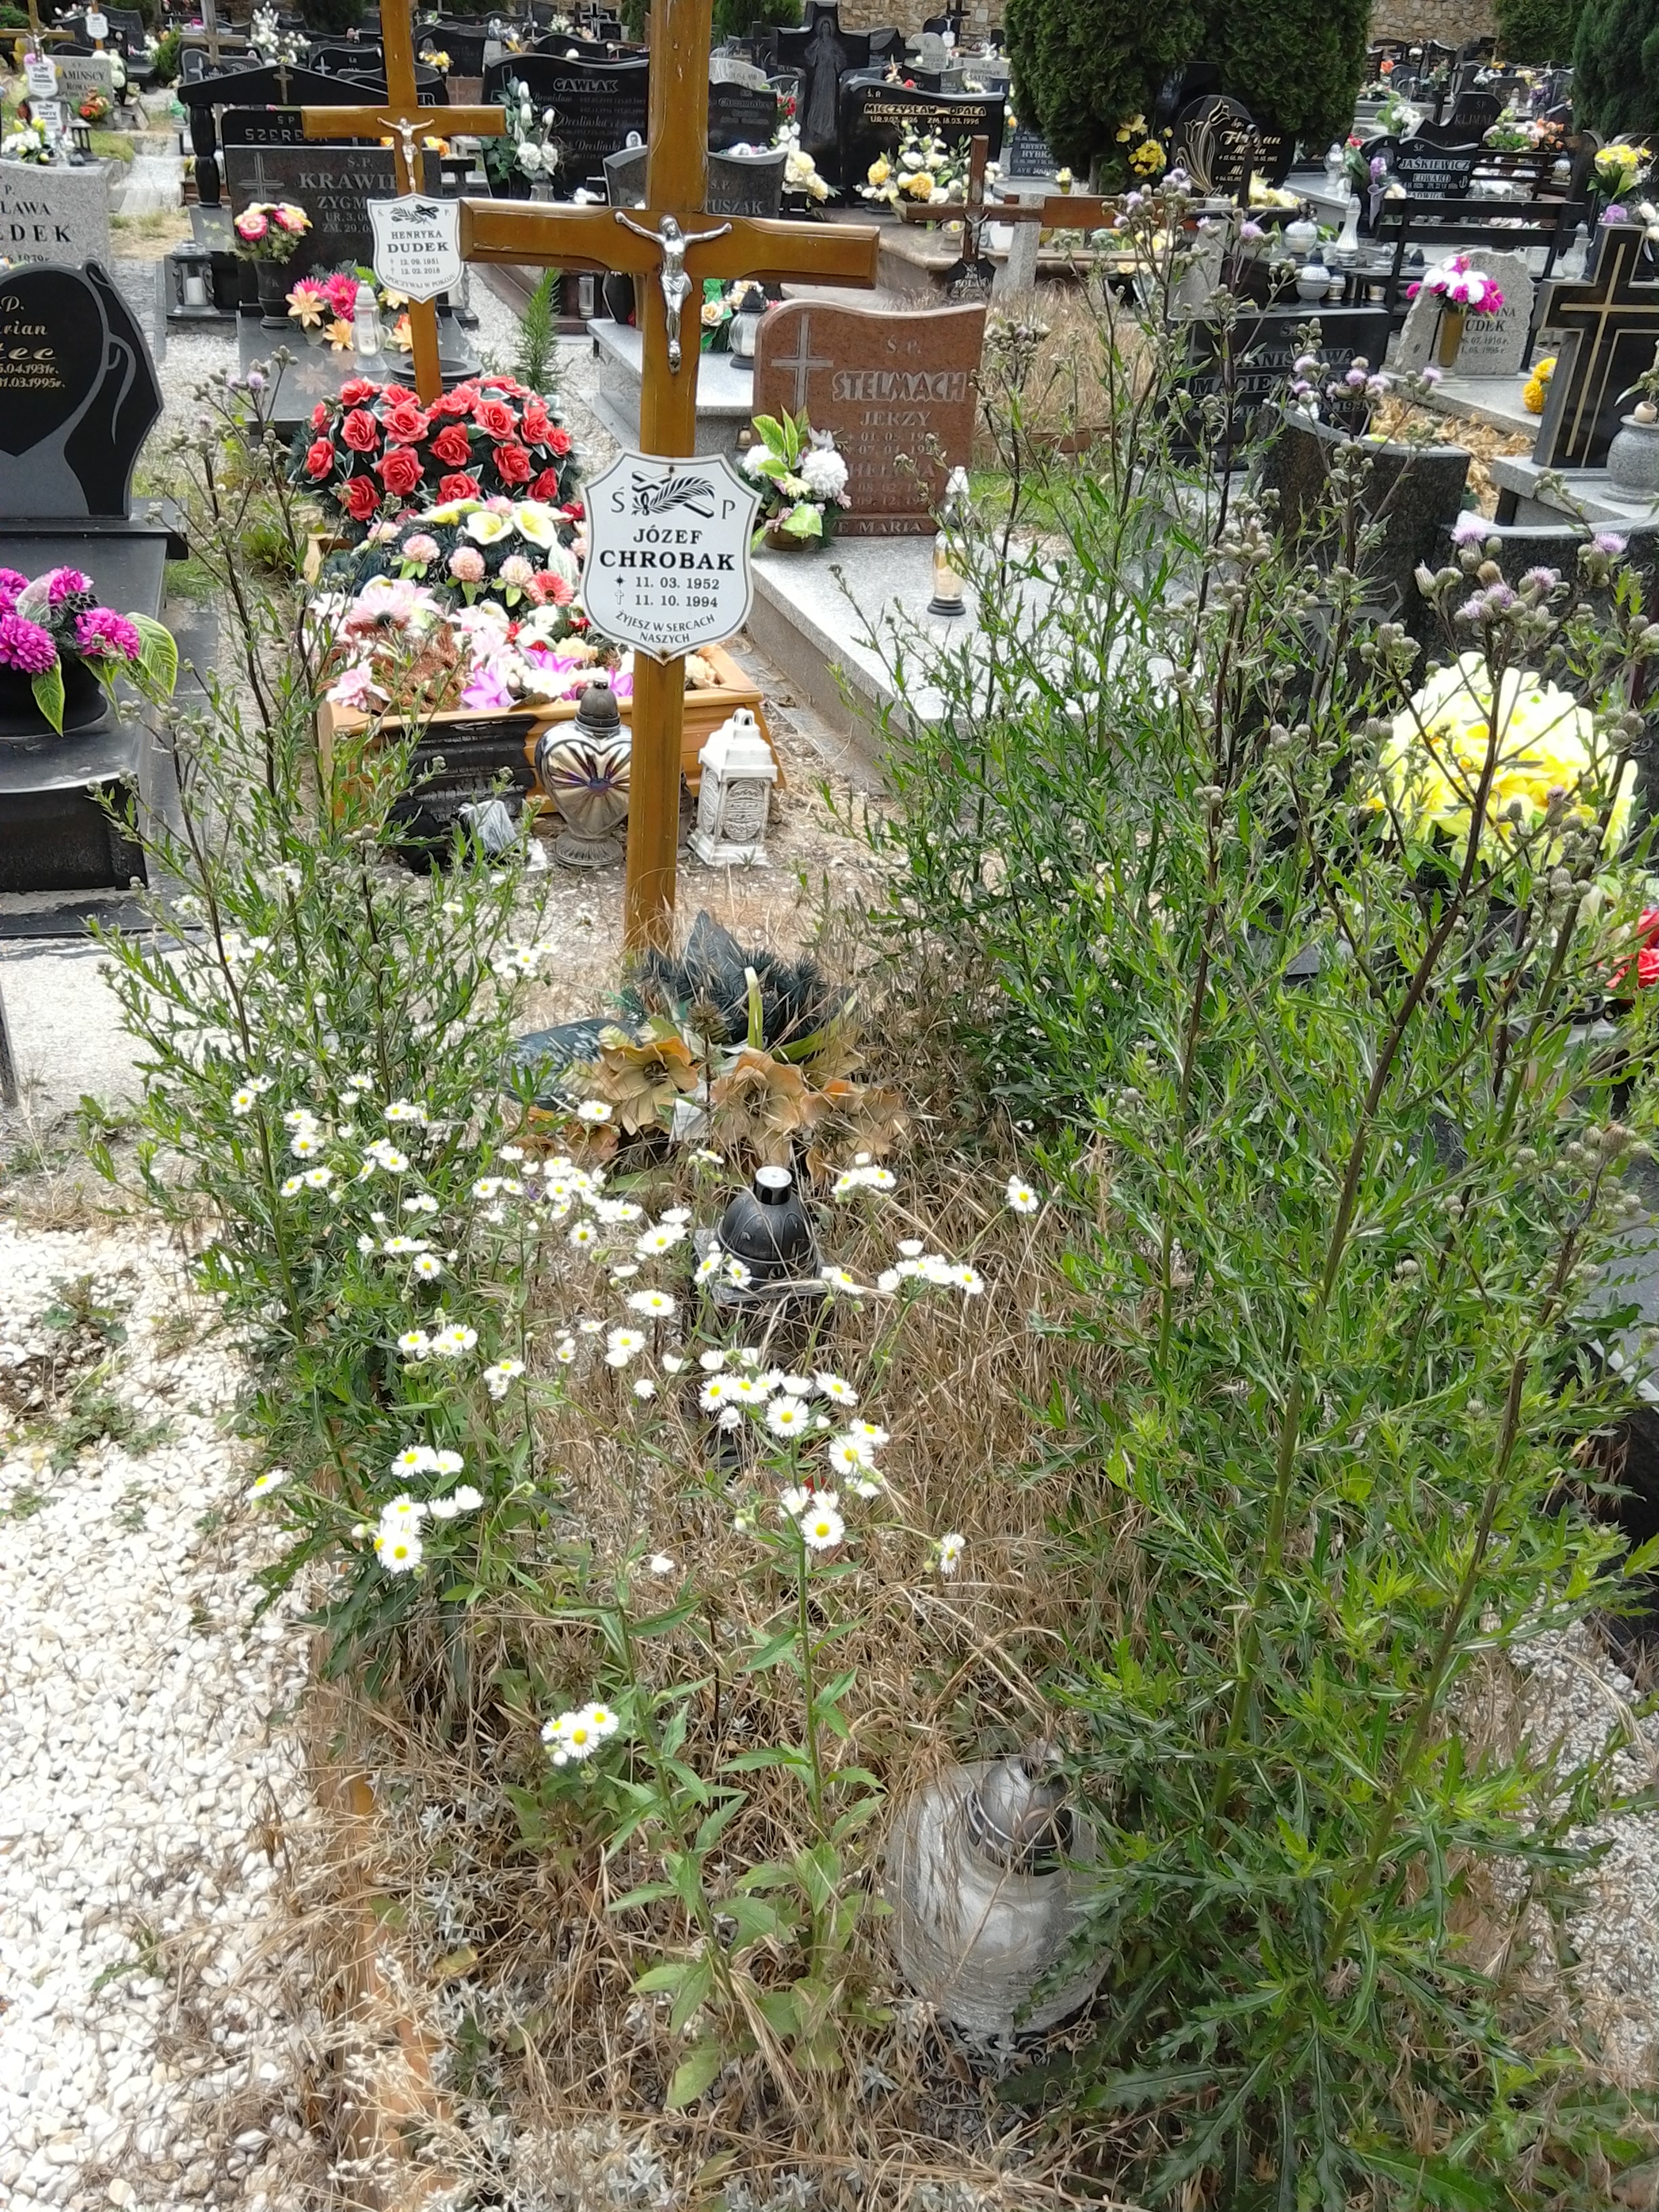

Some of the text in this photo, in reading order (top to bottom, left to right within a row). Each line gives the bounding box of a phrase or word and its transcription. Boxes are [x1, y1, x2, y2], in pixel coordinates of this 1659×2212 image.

[554, 77, 619, 93] GAWLAK
[1398, 156, 1471, 171] JAŚKIEWICZ
[1412, 173, 1452, 183] EDWARD
[390, 230, 443, 240] HENRYKA
[386, 241, 450, 253] DUDEK
[385, 274, 424, 289] SPOCZYWAJ
[432, 273, 456, 287] POKOJU
[0, 320, 48, 335] rian
[1465, 319, 1506, 332] UDEK
[832, 370, 968, 403] STELMACH
[859, 411, 933, 427] JERZY
[611, 486, 736, 520] Ś P
[632, 525, 703, 544] JÓZEF
[859, 520, 922, 534] MARIA
[599, 550, 736, 571] CHROBAK
[635, 576, 720, 590] 11. 03. 1952
[634, 594, 718, 608] 11. 10. 1994
[615, 609, 716, 632] ŻYJESZ W SERCACH
[639, 631, 690, 644] NASZYCH
